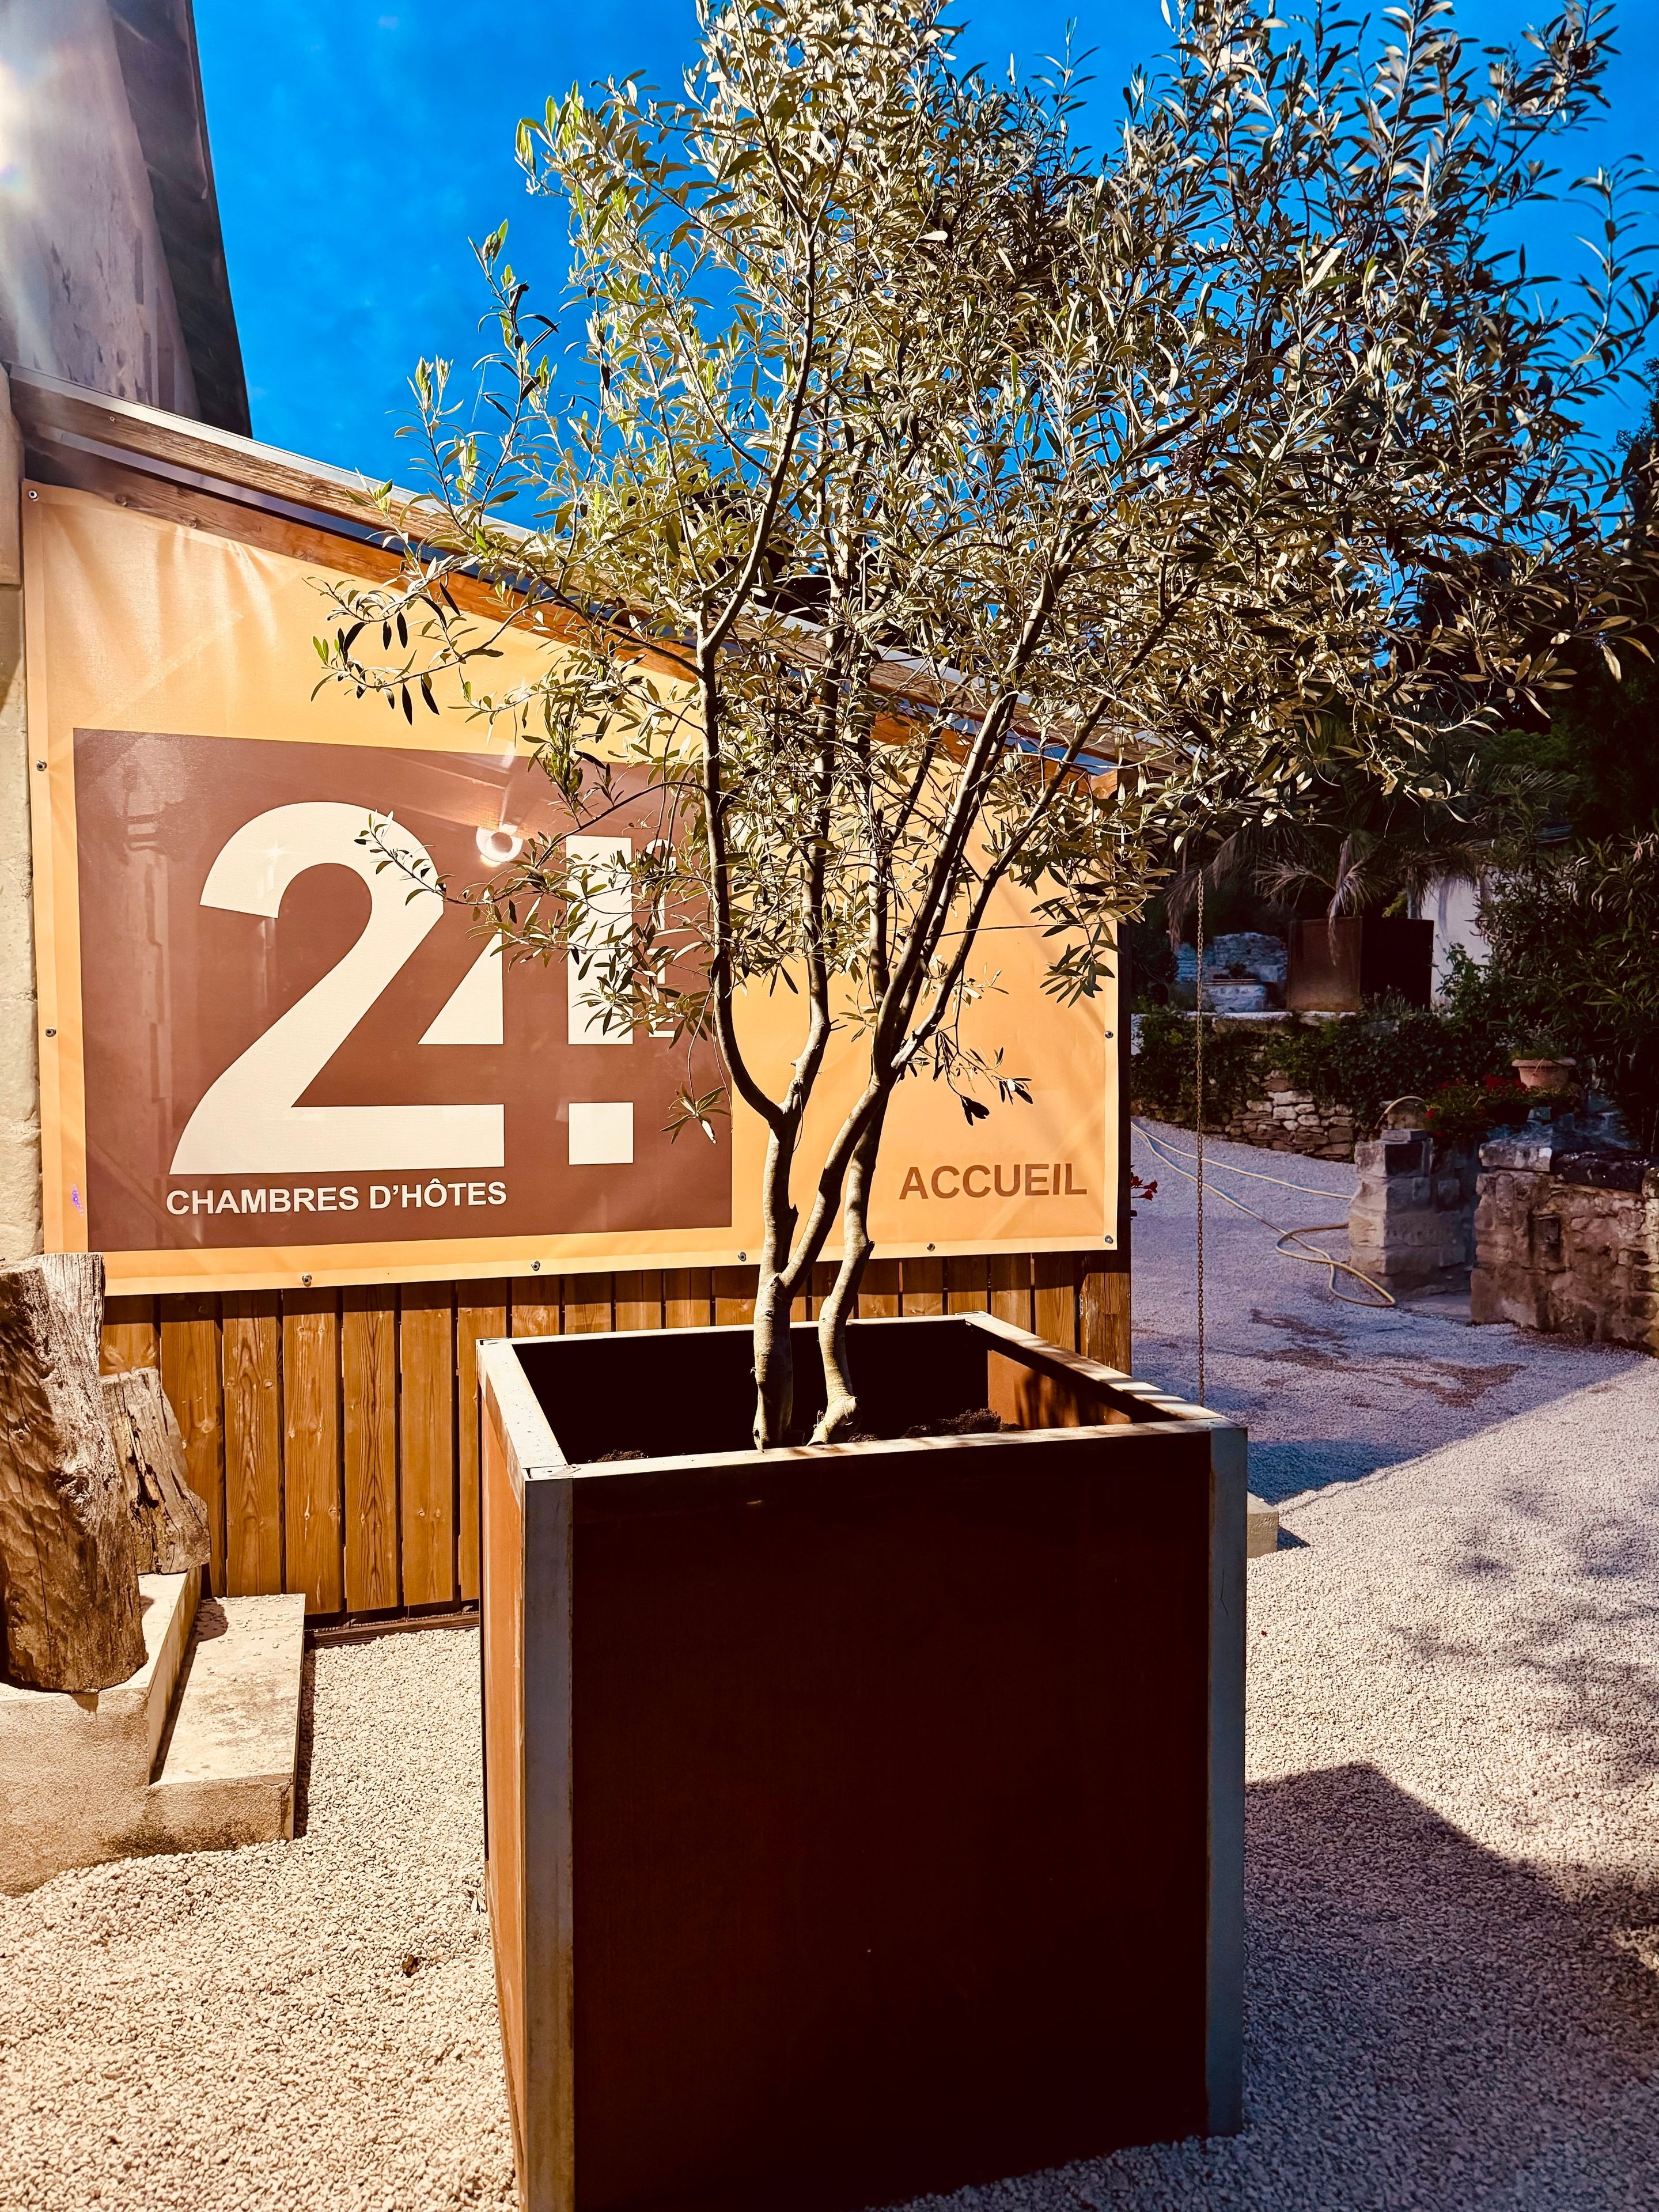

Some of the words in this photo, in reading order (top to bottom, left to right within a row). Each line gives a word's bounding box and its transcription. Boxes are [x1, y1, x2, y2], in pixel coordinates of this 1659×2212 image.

[166, 1186, 359, 1215] CHAMBRES
[370, 1178, 507, 1209] D’HÔTES
[899, 1163, 1088, 1200] ACCUEIL
